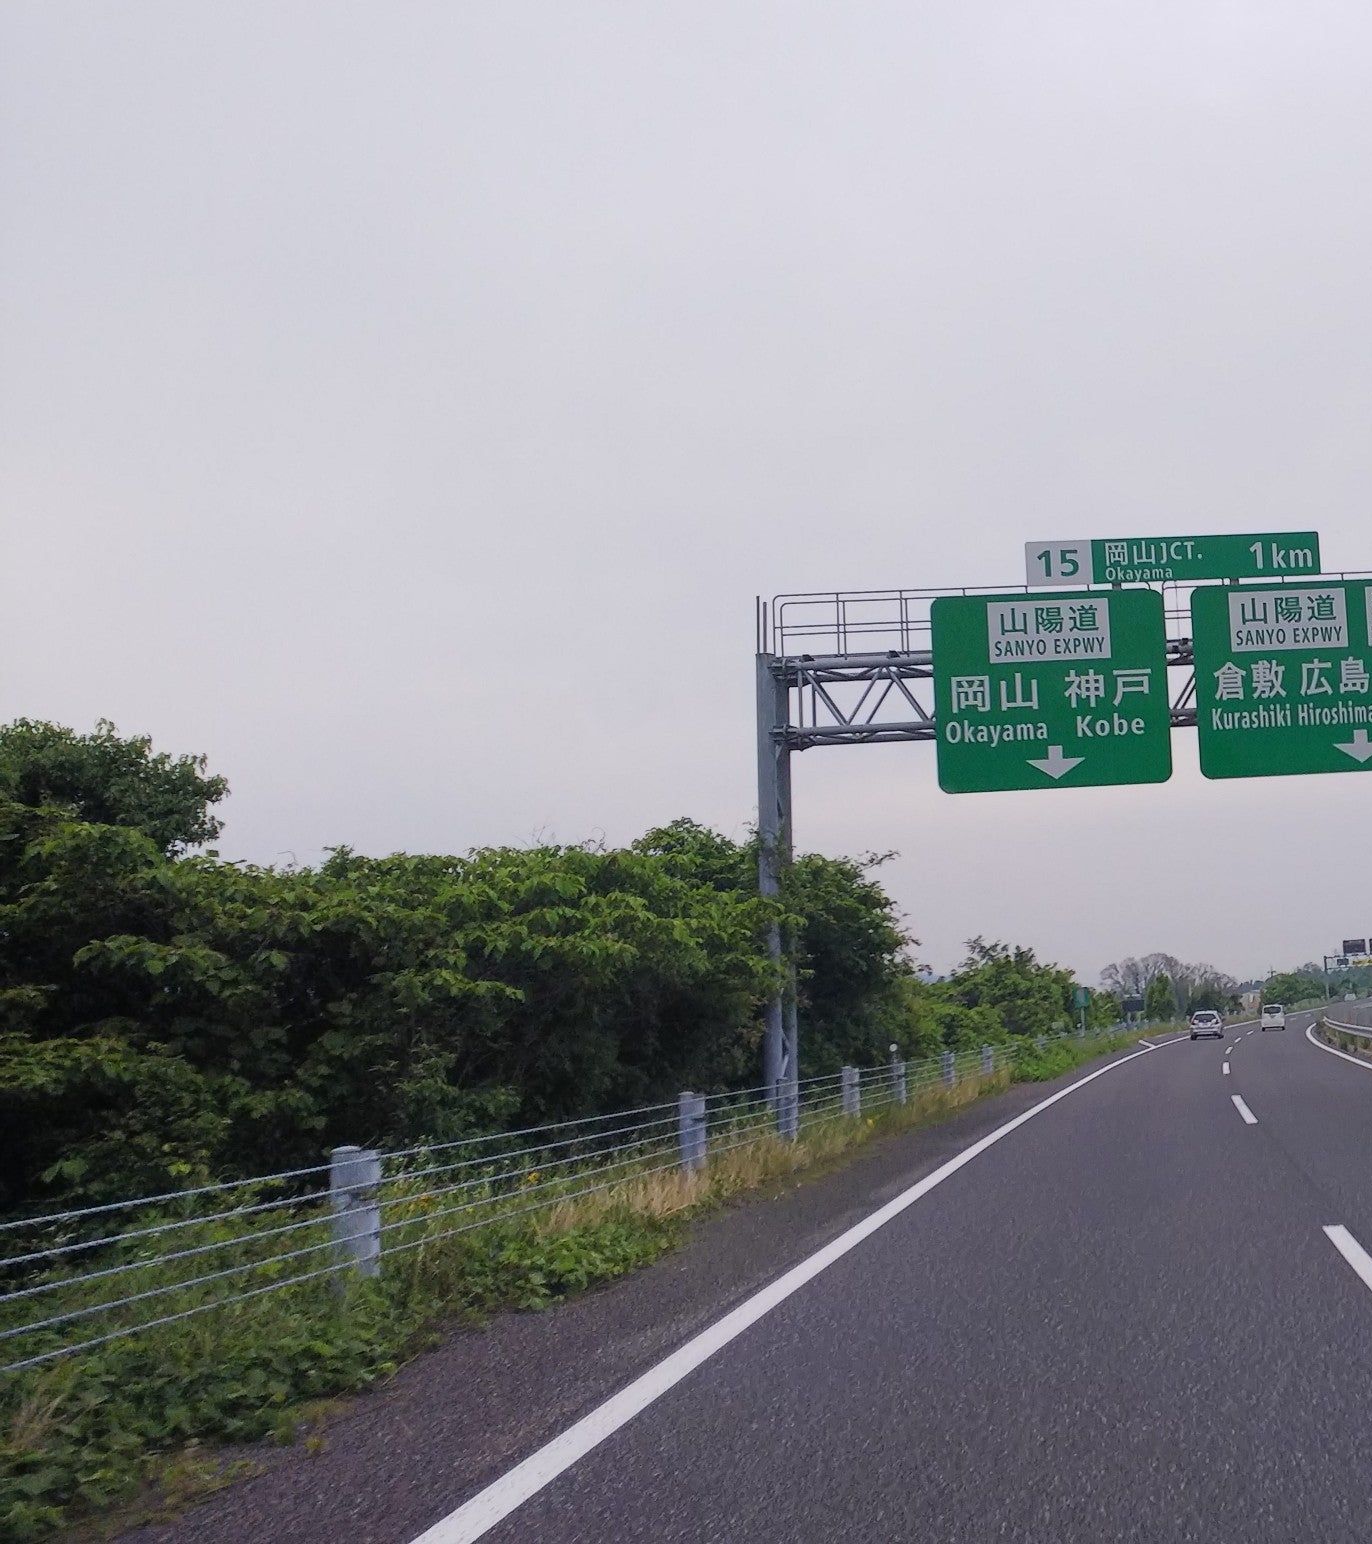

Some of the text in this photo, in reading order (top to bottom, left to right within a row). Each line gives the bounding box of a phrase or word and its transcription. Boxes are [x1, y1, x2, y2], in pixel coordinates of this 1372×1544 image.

[1037, 549, 1080, 578] 15
[1105, 566, 1173, 582] Okayama
[1000, 604, 1100, 636] 山陽道
[1240, 594, 1337, 626] 山陽道
[994, 636, 1105, 658] SANYO EXPWY
[1236, 626, 1342, 647] SANYO EXPWY
[950, 668, 1152, 714] 岡山 神戸
[1212, 659, 1288, 701] 倉敷
[1299, 656, 1370, 696] 広島
[945, 712, 1145, 748] Okayama Kobe
[1211, 703, 1291, 731] Kurashiki
